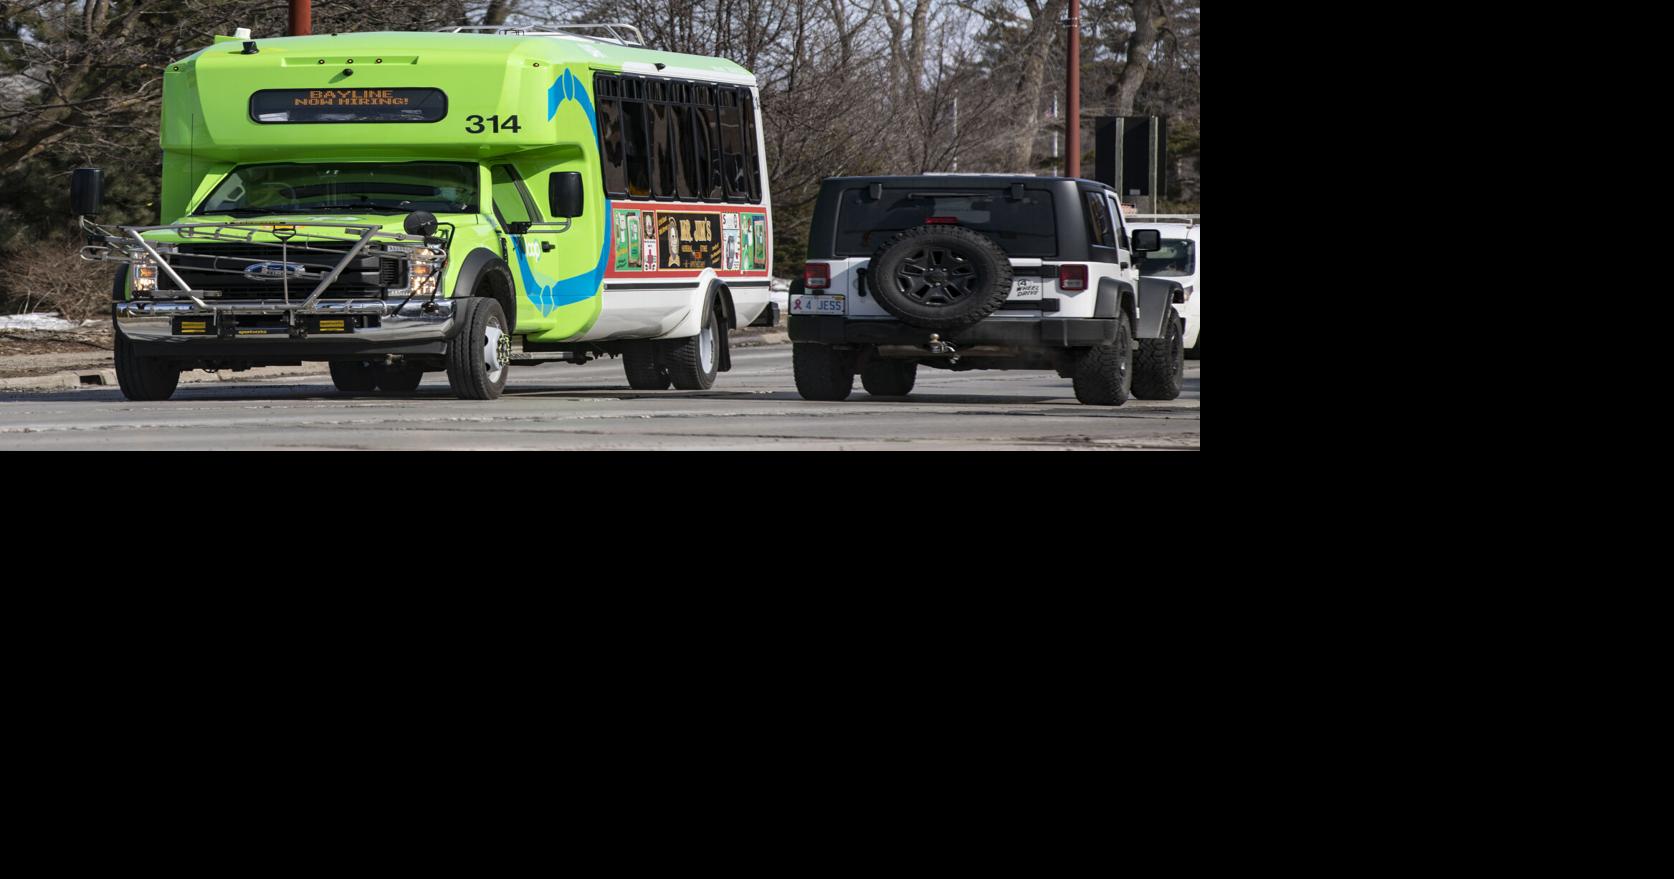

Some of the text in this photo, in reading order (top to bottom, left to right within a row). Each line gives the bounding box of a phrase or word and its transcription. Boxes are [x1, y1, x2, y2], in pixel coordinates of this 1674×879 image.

[310, 90, 393, 98] BAYLINE
[294, 98, 333, 106] NOW
[465, 114, 522, 134] 314
[805, 300, 841, 310] 4 JESS
